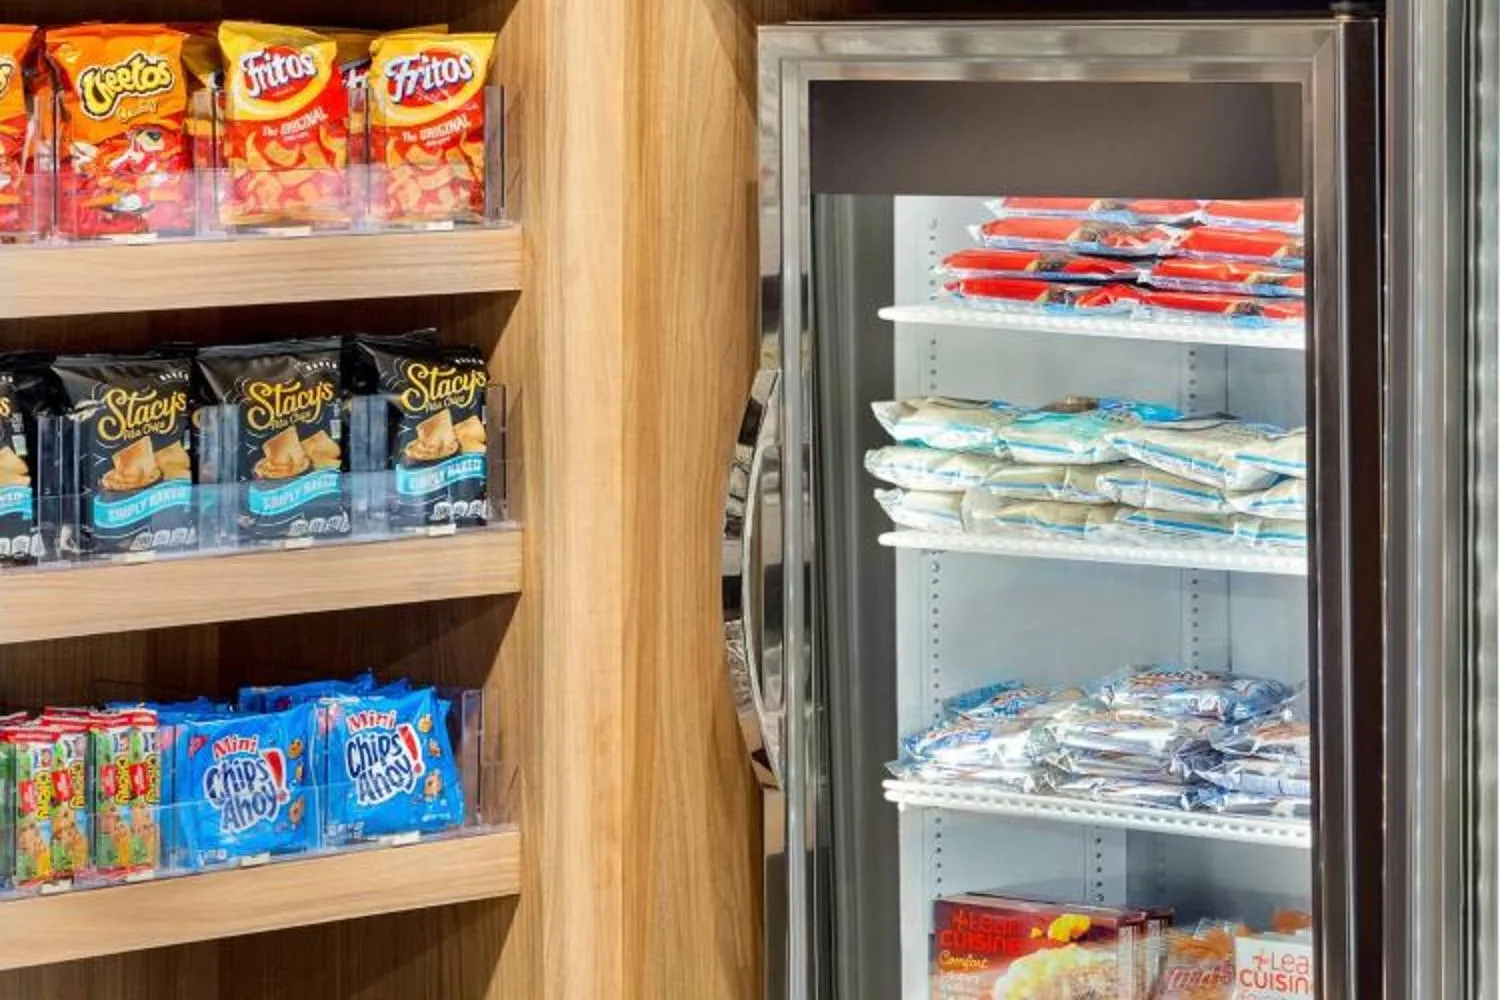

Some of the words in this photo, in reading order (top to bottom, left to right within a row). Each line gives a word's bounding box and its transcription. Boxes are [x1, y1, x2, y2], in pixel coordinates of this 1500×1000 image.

[81, 53, 173, 116] Cheetos
[239, 47, 317, 98] Fritos
[384, 53, 474, 103] Fritos
[247, 380, 335, 431] Stacy's
[400, 363, 487, 413] Stacy's
[97, 387, 187, 441] Stacy's
[349, 710, 397, 732] Mini
[213, 735, 259, 758] Mini
[347, 732, 404, 777] Chips
[205, 759, 271, 802] Chips
[1239, 969, 1311, 995] CUISIN
[1271, 951, 1310, 975] Lea
